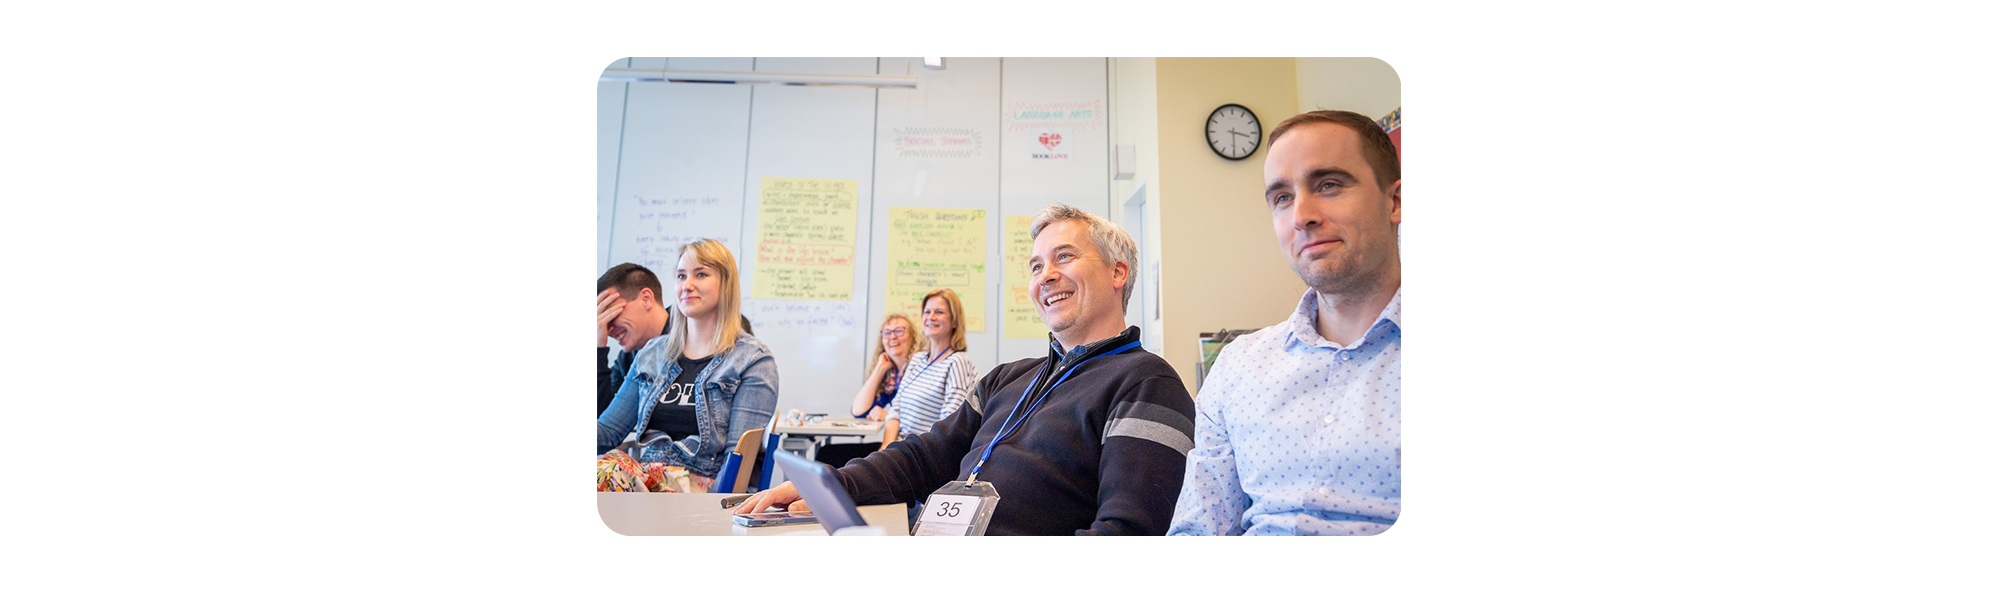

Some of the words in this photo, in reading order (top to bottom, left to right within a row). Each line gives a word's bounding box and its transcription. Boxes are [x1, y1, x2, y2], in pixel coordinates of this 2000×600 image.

[1013, 110, 1064, 119] LANGUAGE
[1069, 109, 1093, 118] ARTS
[937, 501, 962, 518] 35
